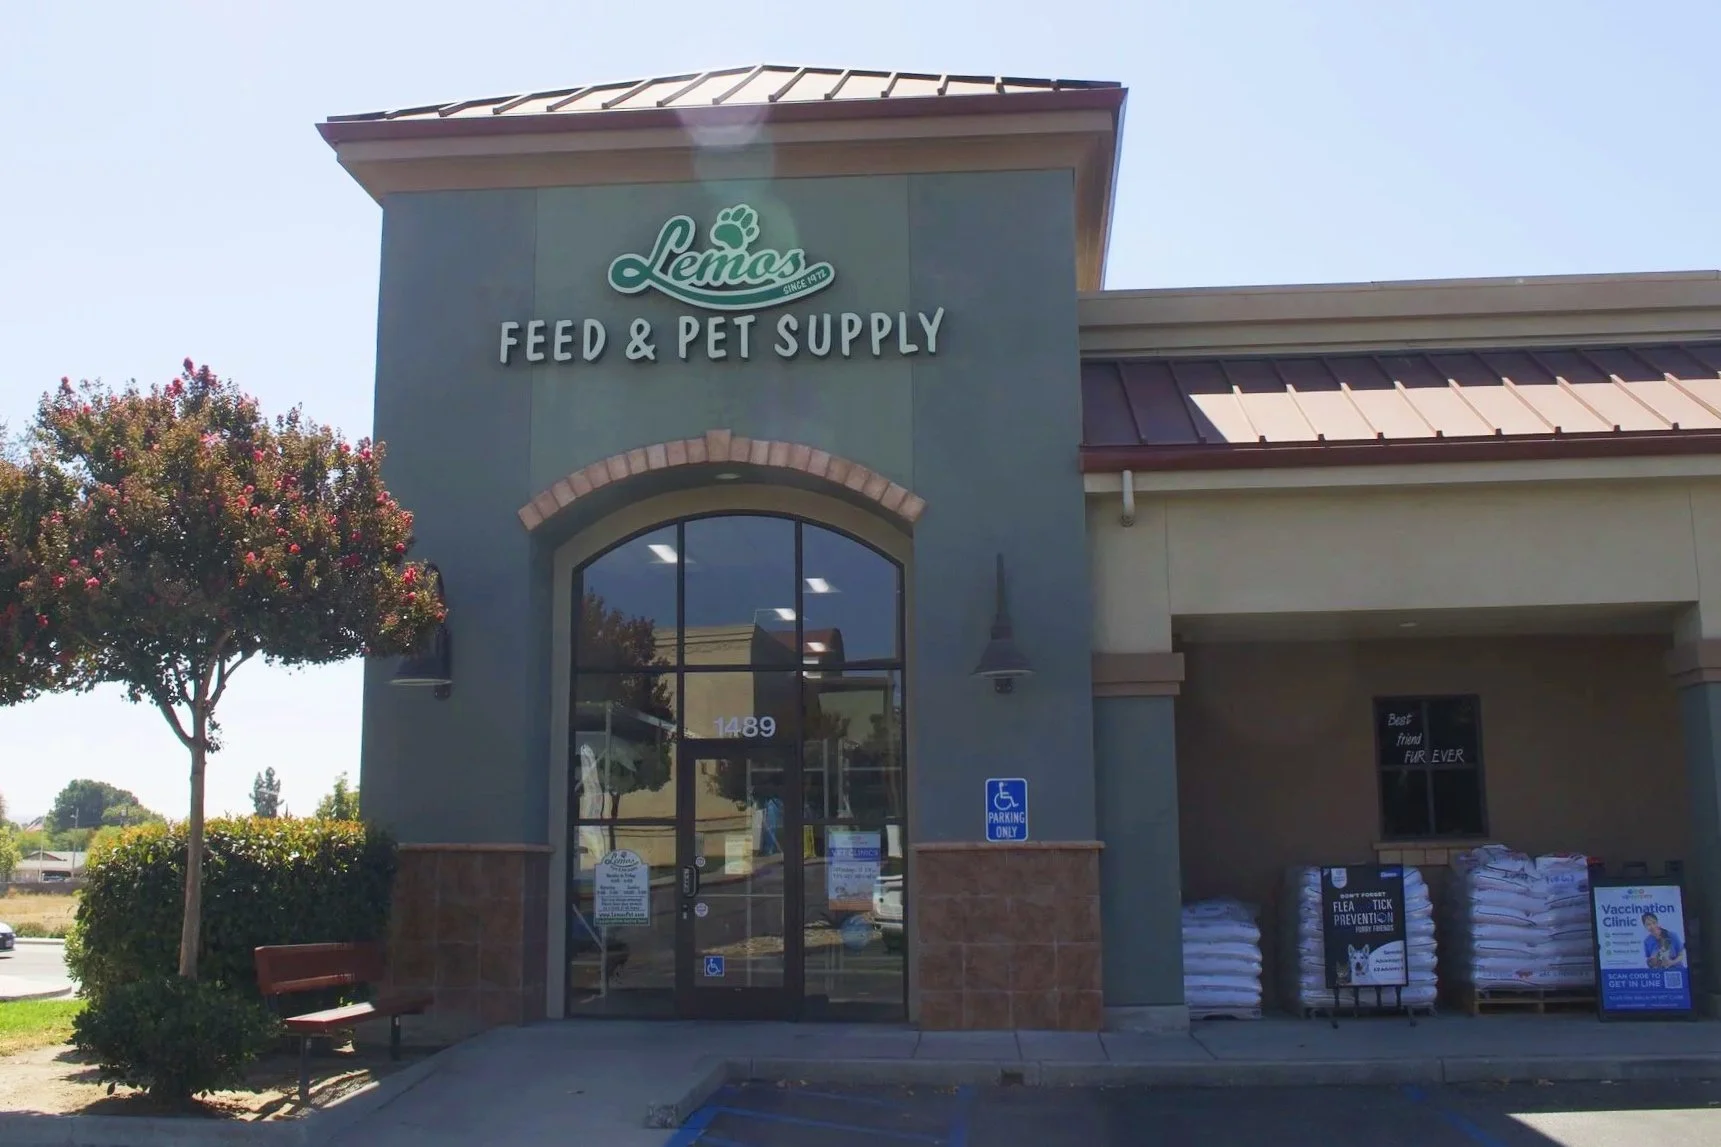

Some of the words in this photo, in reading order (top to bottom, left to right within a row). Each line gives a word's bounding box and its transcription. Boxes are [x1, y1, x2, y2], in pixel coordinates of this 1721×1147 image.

[608, 214, 830, 309] Lemos
[783, 278, 807, 295] SINCE
[807, 269, 827, 284] 1972
[500, 318, 606, 364] FEED
[625, 317, 656, 361] &
[678, 314, 756, 359] PET
[774, 306, 945, 358] SUPPLY
[714, 716, 776, 738] 1489
[1387, 713, 1412, 727] Best
[1396, 732, 1422, 747] friend
[1404, 749, 1426, 764] FUR
[1431, 748, 1465, 763] EVER
[988, 811, 1025, 824] PARKING
[996, 825, 1018, 838] ONLY
[604, 852, 639, 867] Lemos
[1333, 901, 1355, 912] FLEA
[1372, 898, 1393, 910] TICK
[1601, 902, 1676, 914] Vaccination
[1334, 912, 1394, 926] PREVENTION
[1602, 917, 1637, 928] Clinic
[1608, 980, 1626, 988] GET
[1628, 980, 1639, 988] IN
[1641, 979, 1661, 988] LINE
